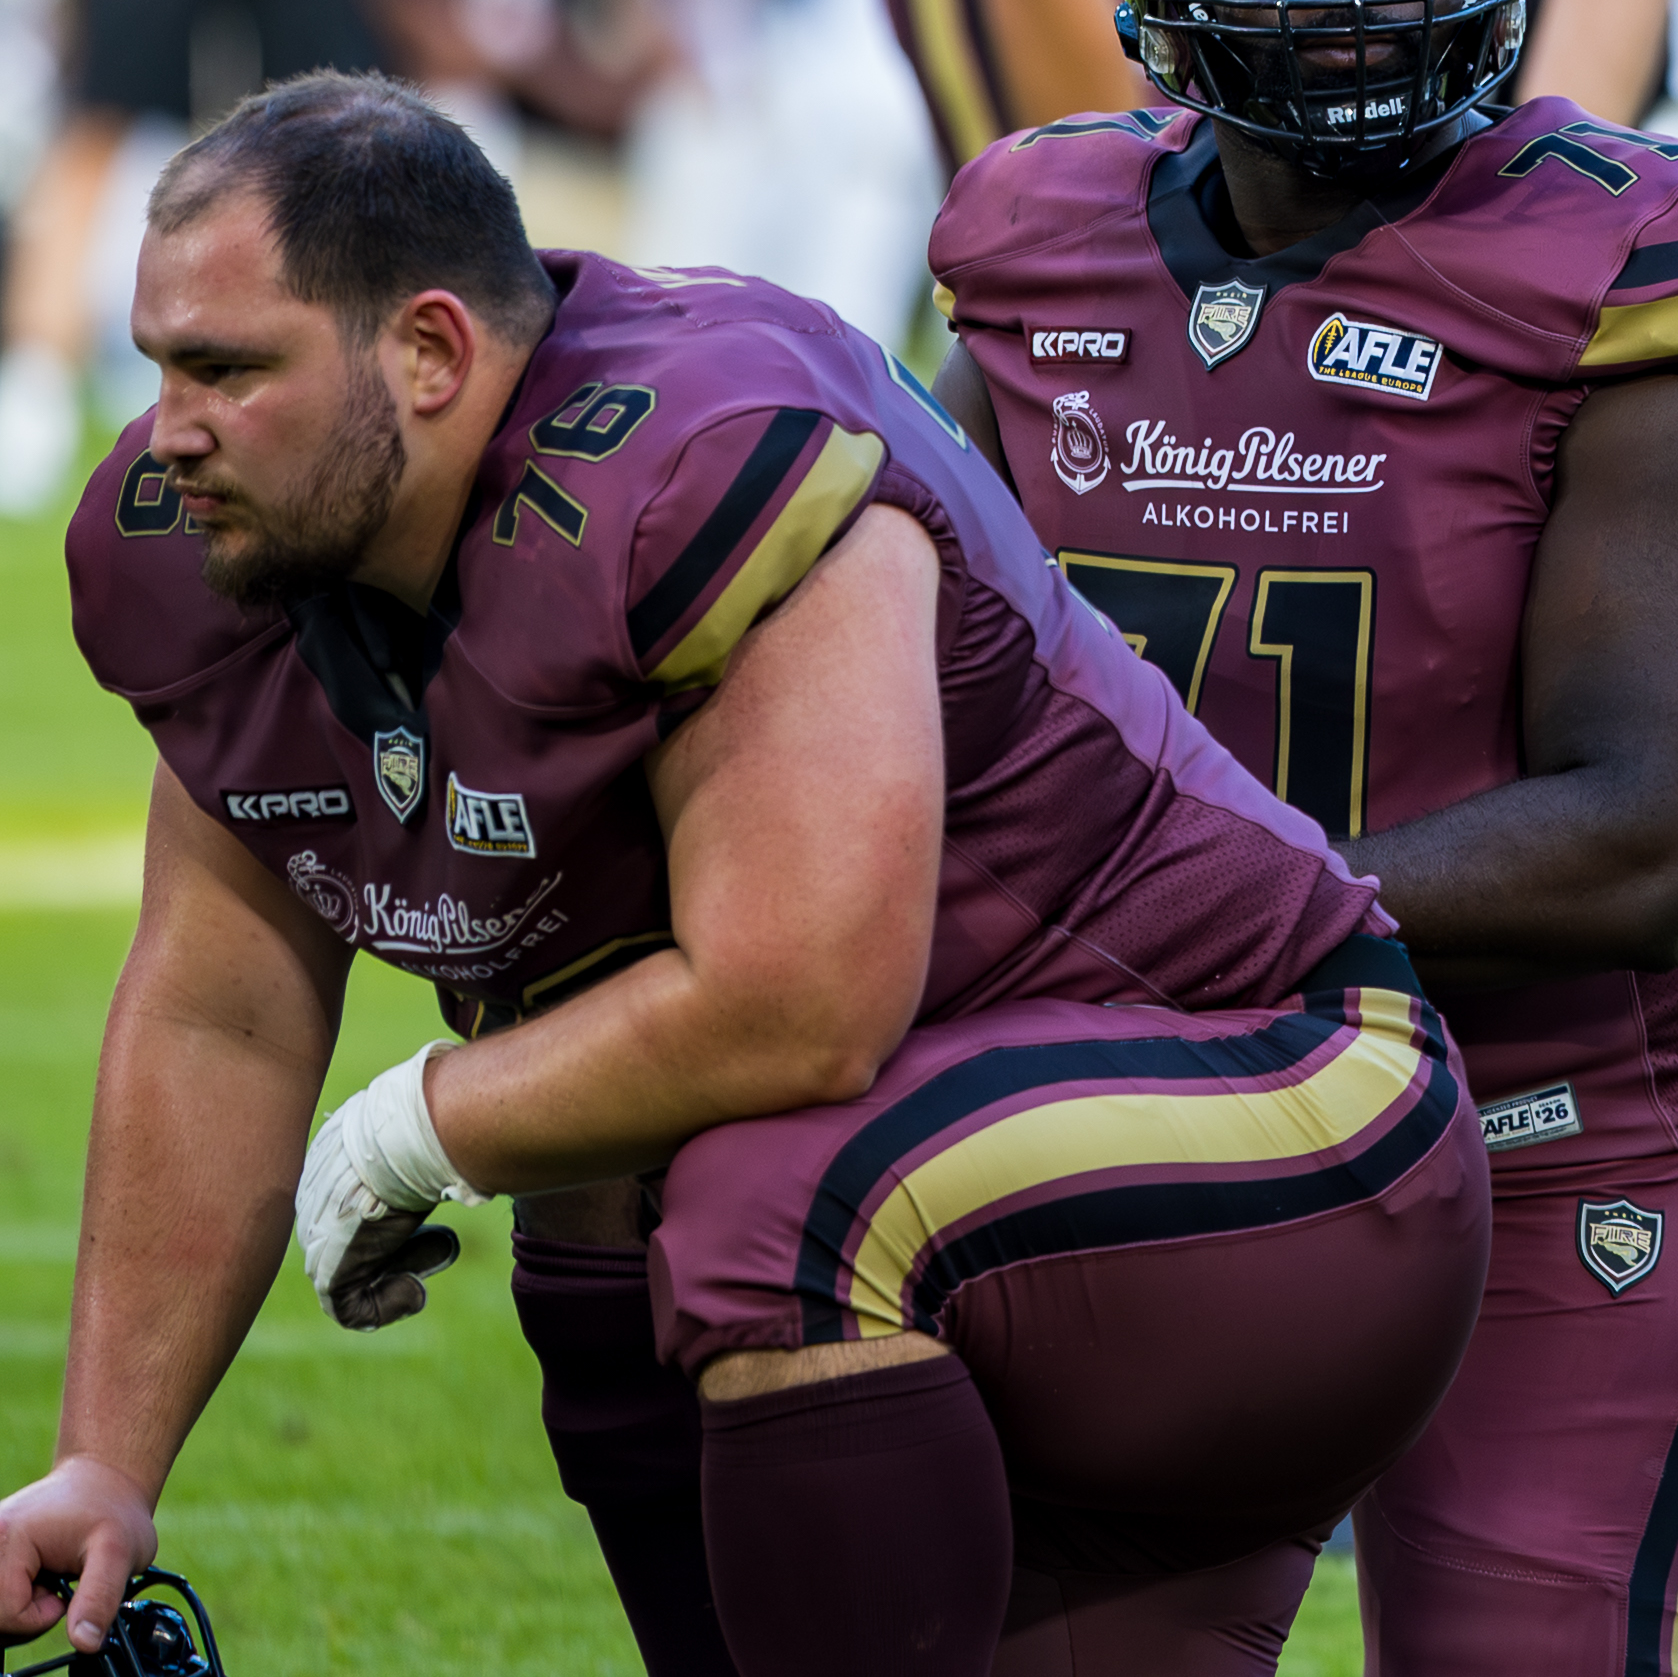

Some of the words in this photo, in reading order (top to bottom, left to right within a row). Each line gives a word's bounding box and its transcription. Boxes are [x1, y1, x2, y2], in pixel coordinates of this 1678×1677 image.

[1032, 331, 1125, 358] KPRO
[1322, 327, 1437, 384] AFLE
[1318, 366, 1336, 375] THE
[1338, 369, 1378, 383] LEAGUE
[492, 381, 656, 548] 76
[1142, 502, 1349, 534] ALKOHOLFREI
[1056, 547, 1376, 842] 71
[227, 789, 350, 820] KPRO
[454, 793, 527, 841] AFLE
[1483, 1109, 1530, 1137] AFLE
[1535, 1103, 1569, 1125] '26
[1589, 1223, 1652, 1254] FIRE
